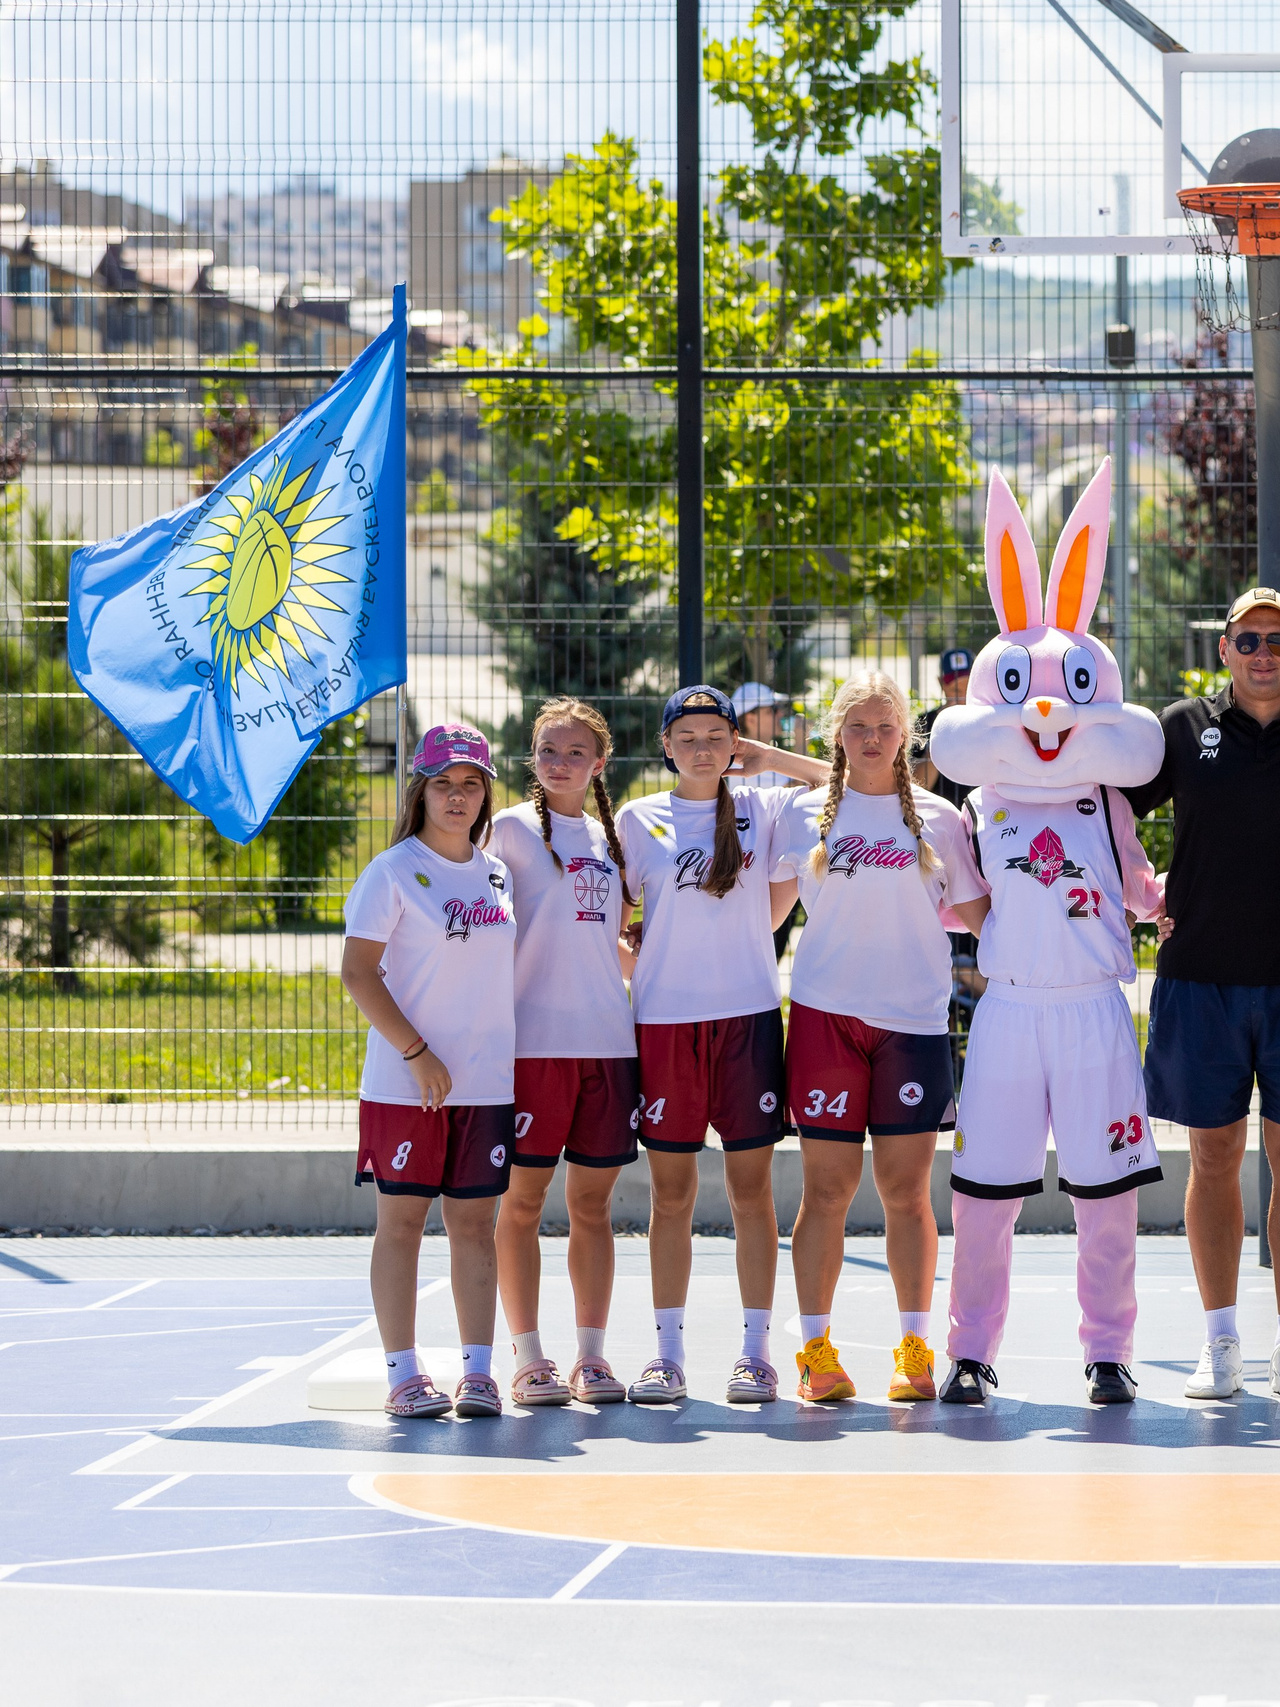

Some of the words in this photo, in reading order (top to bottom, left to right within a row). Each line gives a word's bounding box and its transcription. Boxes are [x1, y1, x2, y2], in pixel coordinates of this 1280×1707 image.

[1078, 802, 1096, 811] РФБ
[674, 847, 756, 892] Рун
[827, 834, 918, 879] Рубин
[1030, 855, 1065, 878] Рубин
[443, 896, 511, 942] Рубин
[803, 1089, 849, 1118] 34
[1106, 1112, 1145, 1155] 23
[391, 1140, 413, 1172] 8
